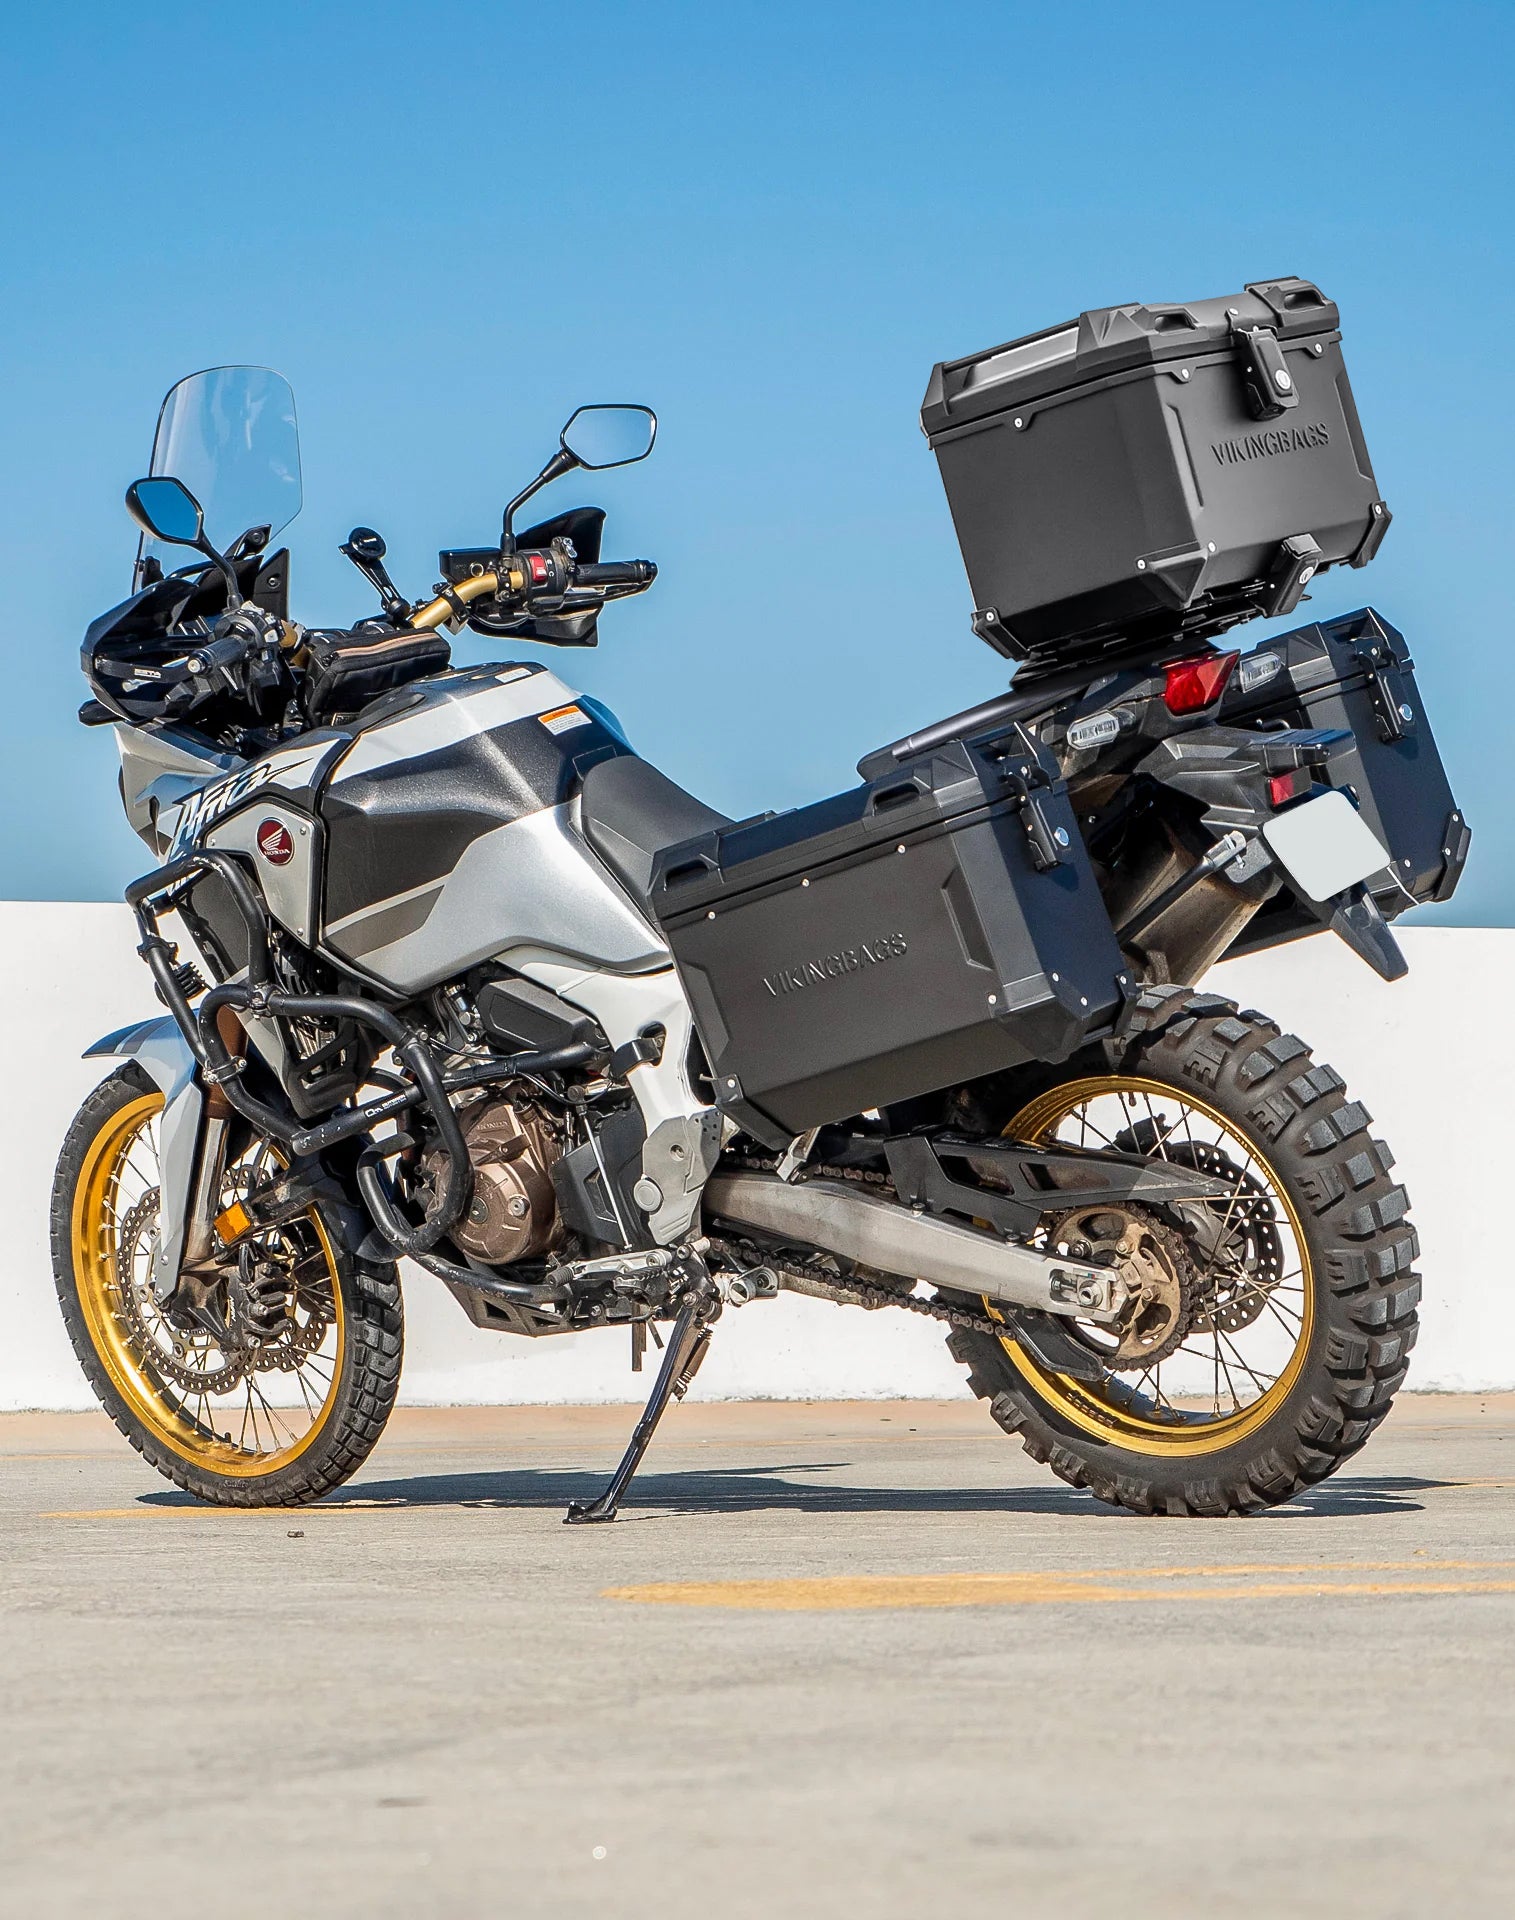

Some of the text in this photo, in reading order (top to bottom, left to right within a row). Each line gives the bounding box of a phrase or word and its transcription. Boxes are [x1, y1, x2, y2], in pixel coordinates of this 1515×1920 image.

[1210, 422, 1329, 466] VIKINGBAGS
[264, 848, 291, 856] HONDA
[763, 933, 907, 996] VIKINGBAGS
